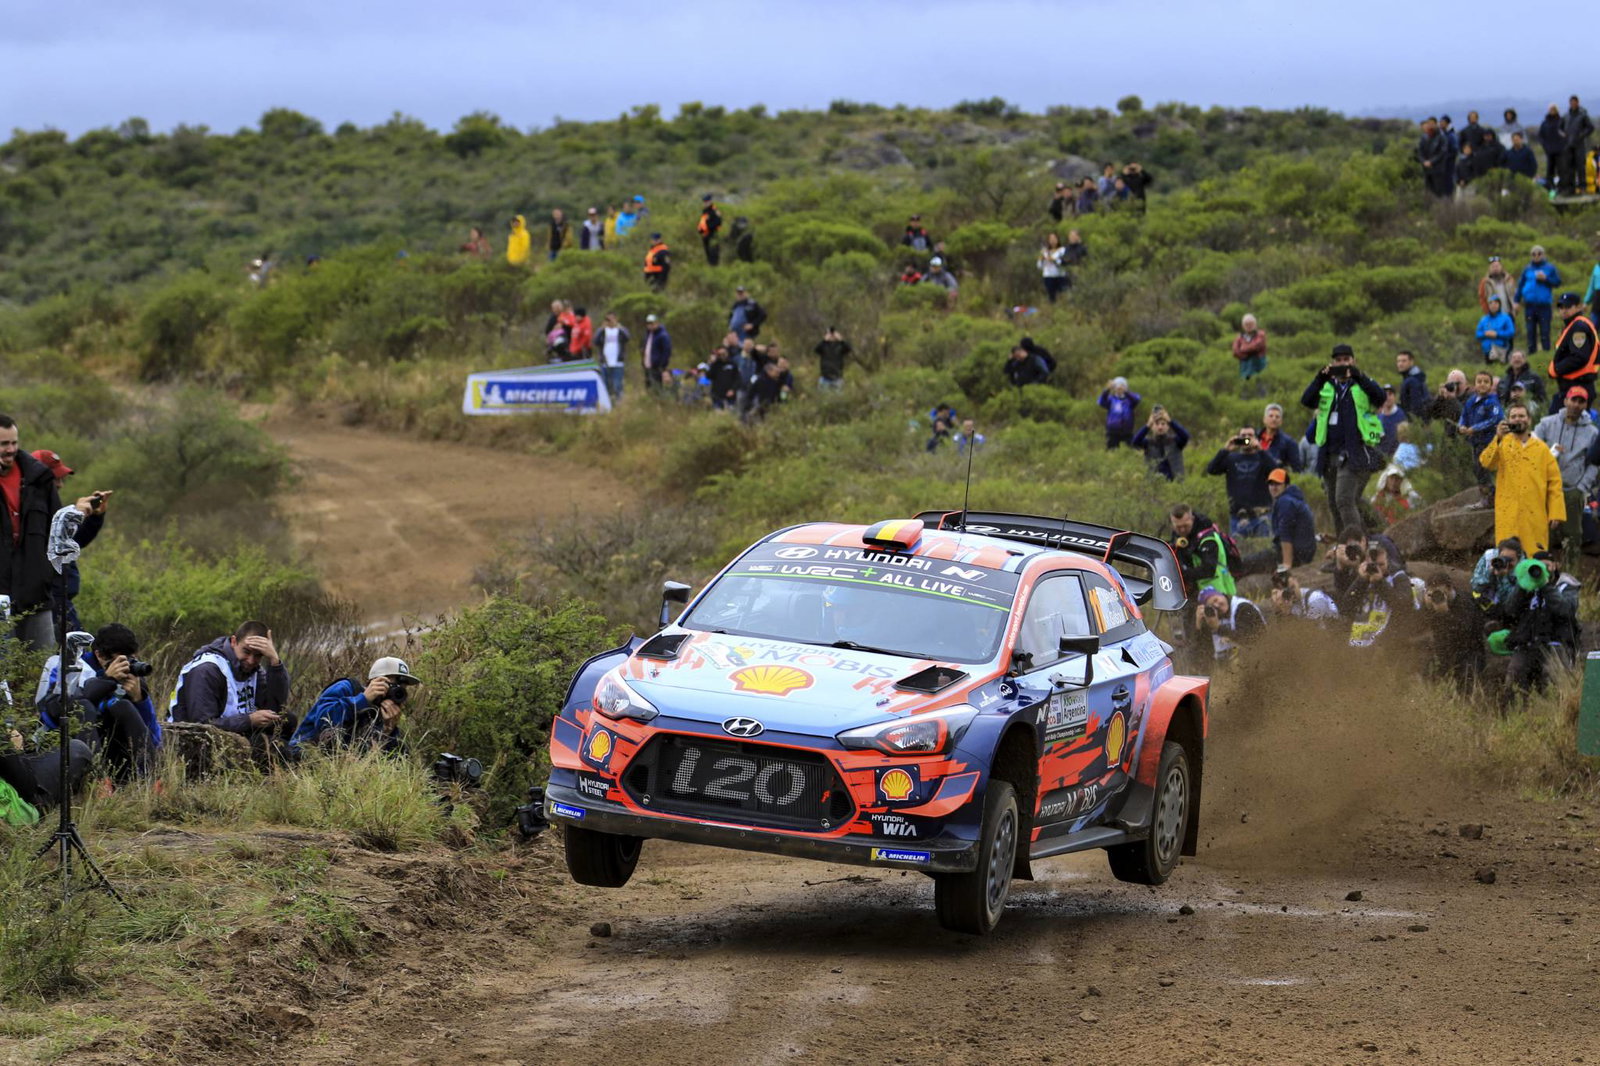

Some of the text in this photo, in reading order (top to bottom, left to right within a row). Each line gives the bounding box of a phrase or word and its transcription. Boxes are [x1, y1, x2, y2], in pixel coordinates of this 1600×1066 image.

[505, 388, 587, 401] MICHELIN
[1007, 529, 1109, 549] HYUNDA
[824, 549, 932, 571] HYUNDAI
[879, 574, 915, 588] ALL
[921, 579, 964, 596] LIVE
[740, 642, 841, 657] HYUNDAI
[760, 649, 897, 678] MOBIS
[1063, 705, 1086, 721] Argentina
[588, 779, 610, 791] HYUNDAI
[588, 786, 603, 797] STEEL
[871, 814, 904, 823] HYUNDAI
[888, 853, 926, 861] MICHELIN
